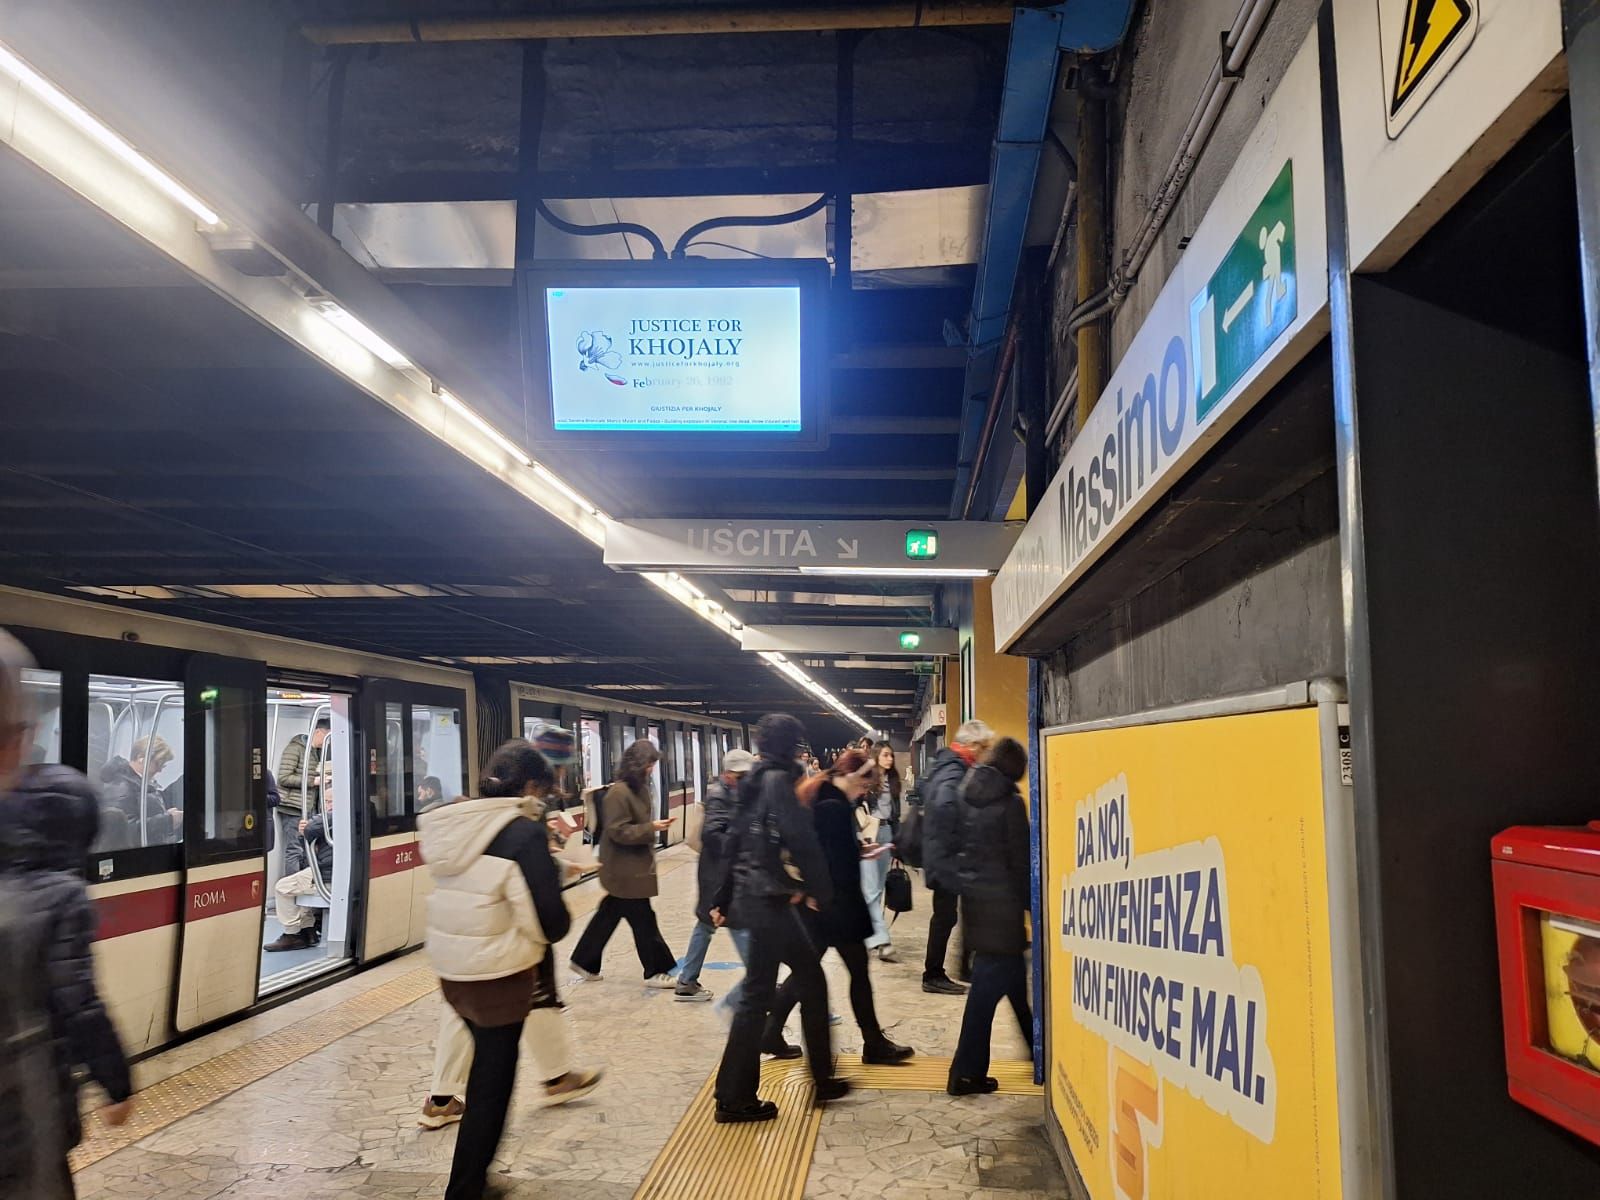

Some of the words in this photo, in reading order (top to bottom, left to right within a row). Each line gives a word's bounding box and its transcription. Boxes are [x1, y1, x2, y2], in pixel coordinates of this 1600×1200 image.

[629, 319, 702, 335] JUSTICE
[707, 319, 742, 332] FOR
[628, 338, 743, 359] KHOJALY
[1060, 335, 1188, 574] Massimo
[688, 528, 817, 557] USCITA
[1340, 734, 1349, 743] C
[1342, 751, 1352, 781] 2308
[1077, 812, 1095, 868] DA
[1098, 794, 1130, 870] NOI,
[395, 849, 413, 865] atac
[193, 889, 227, 909] ROMA
[1062, 887, 1076, 937] LA
[1079, 867, 1225, 957] CONVENIENZA
[1073, 955, 1102, 1017] NON
[1104, 963, 1184, 1060] FINISCE
[1189, 986, 1266, 1106] MAI.
